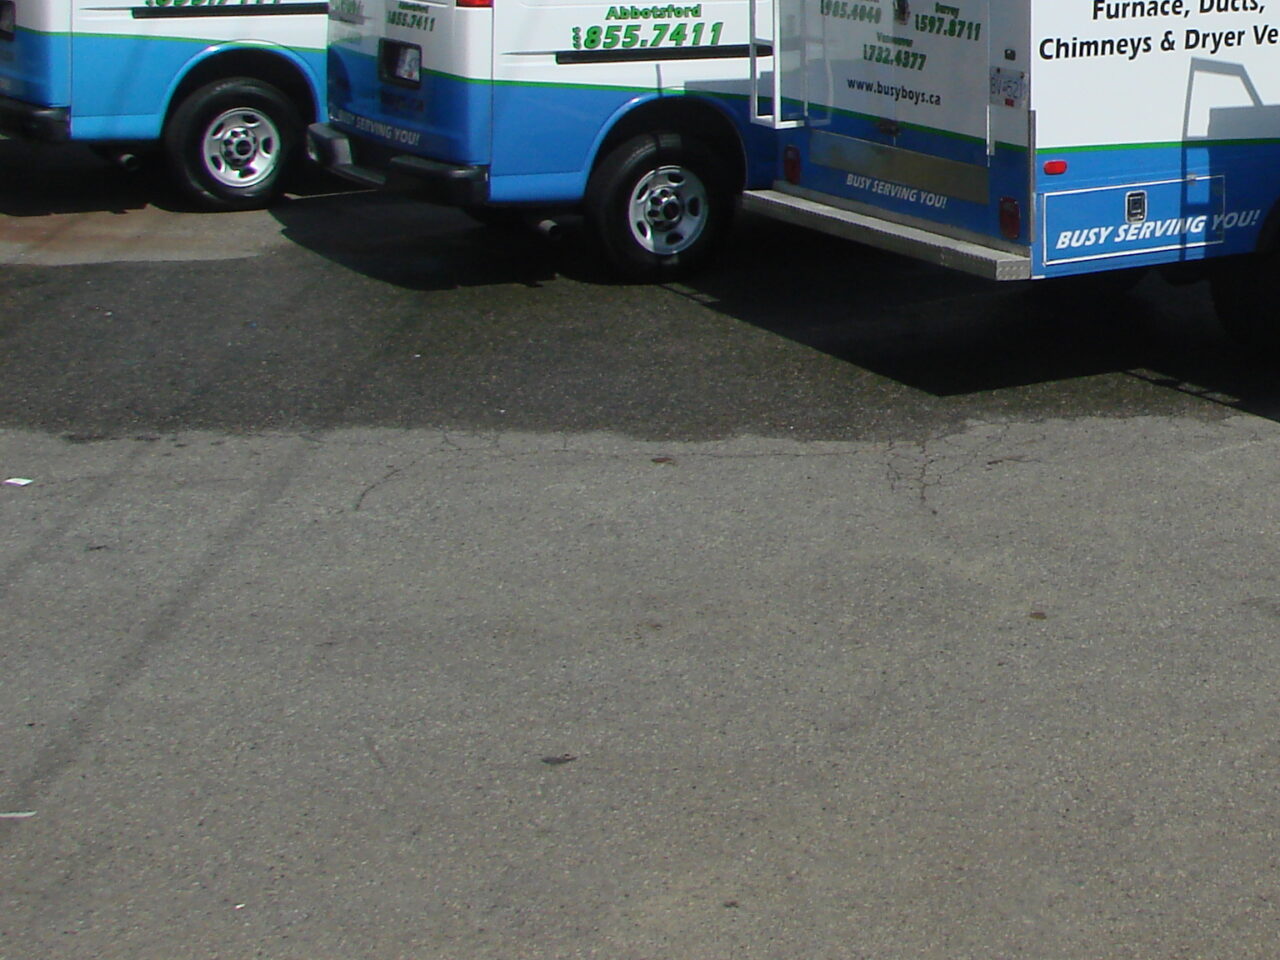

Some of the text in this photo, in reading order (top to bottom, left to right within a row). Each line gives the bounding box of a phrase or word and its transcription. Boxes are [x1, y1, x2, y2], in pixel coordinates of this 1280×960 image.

[606, 4, 701, 20] Abbotsford
[584, 22, 723, 49] 855.7411
[1039, 35, 1152, 60] Chimneys
[1161, 31, 1175, 51] &
[1184, 29, 1246, 53] Dryer
[847, 78, 941, 106] www.busyboys.ca
[846, 173, 948, 208] BUSY SERVING YOU!
[1056, 209, 1261, 250] BUSY SERVING YOU!
